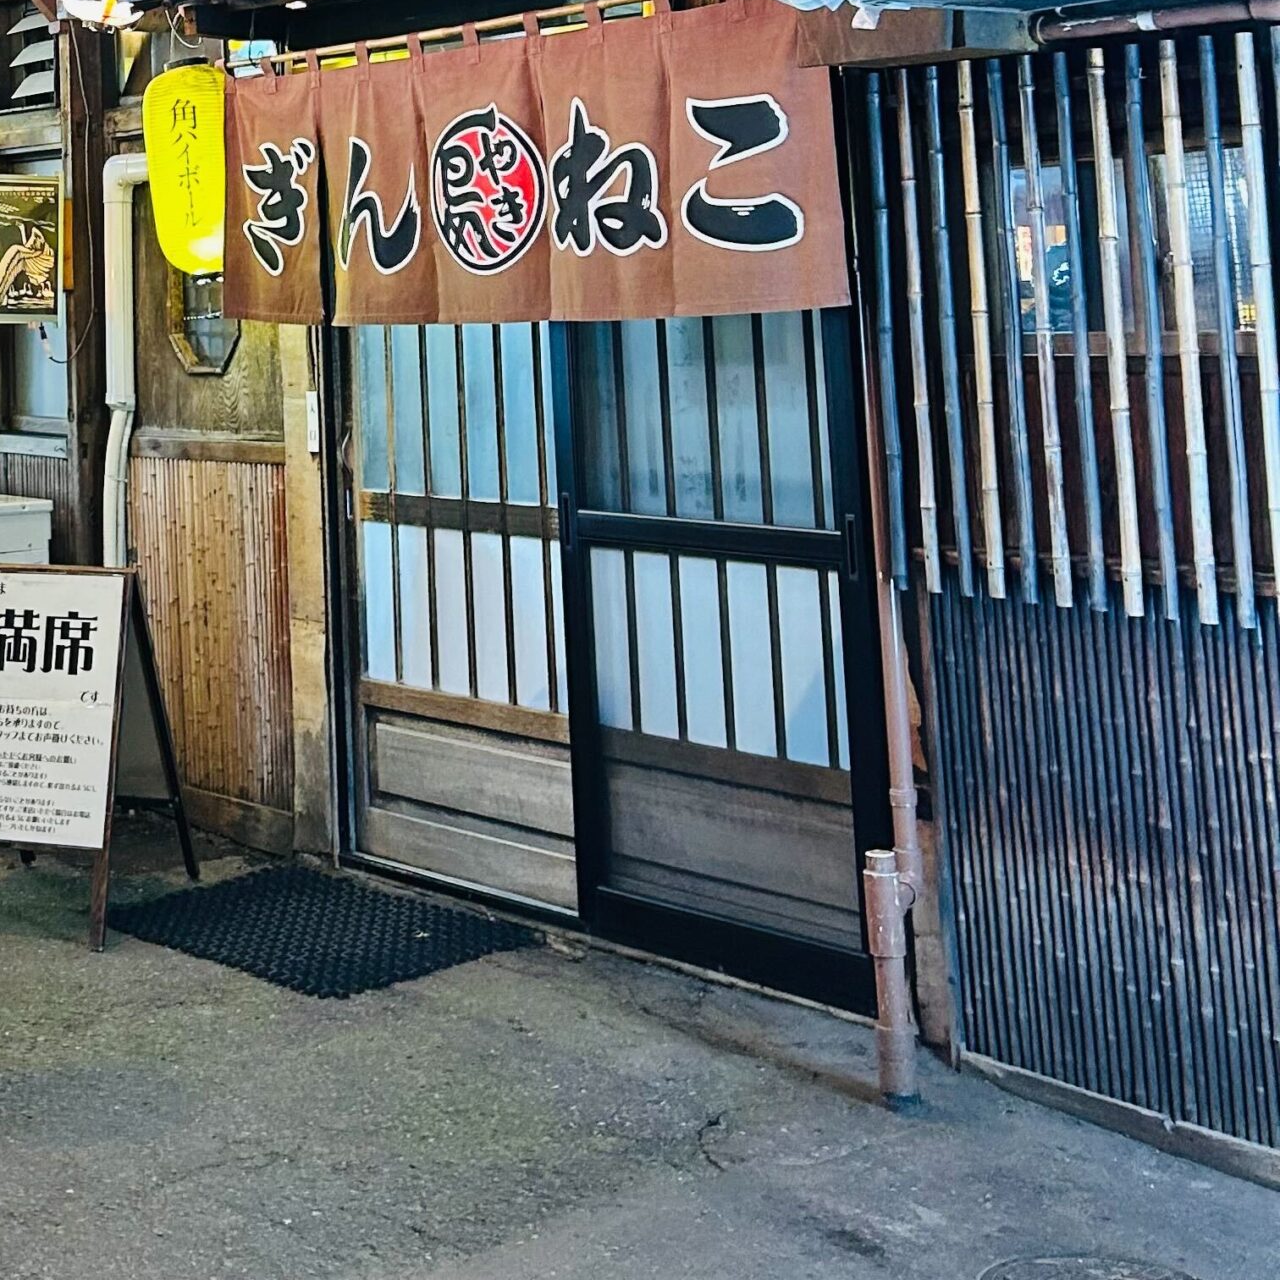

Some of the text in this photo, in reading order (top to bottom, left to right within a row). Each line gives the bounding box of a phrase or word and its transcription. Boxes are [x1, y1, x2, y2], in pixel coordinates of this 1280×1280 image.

[170, 98, 202, 227] 角ハイボール
[80, 690, 100, 703] です
